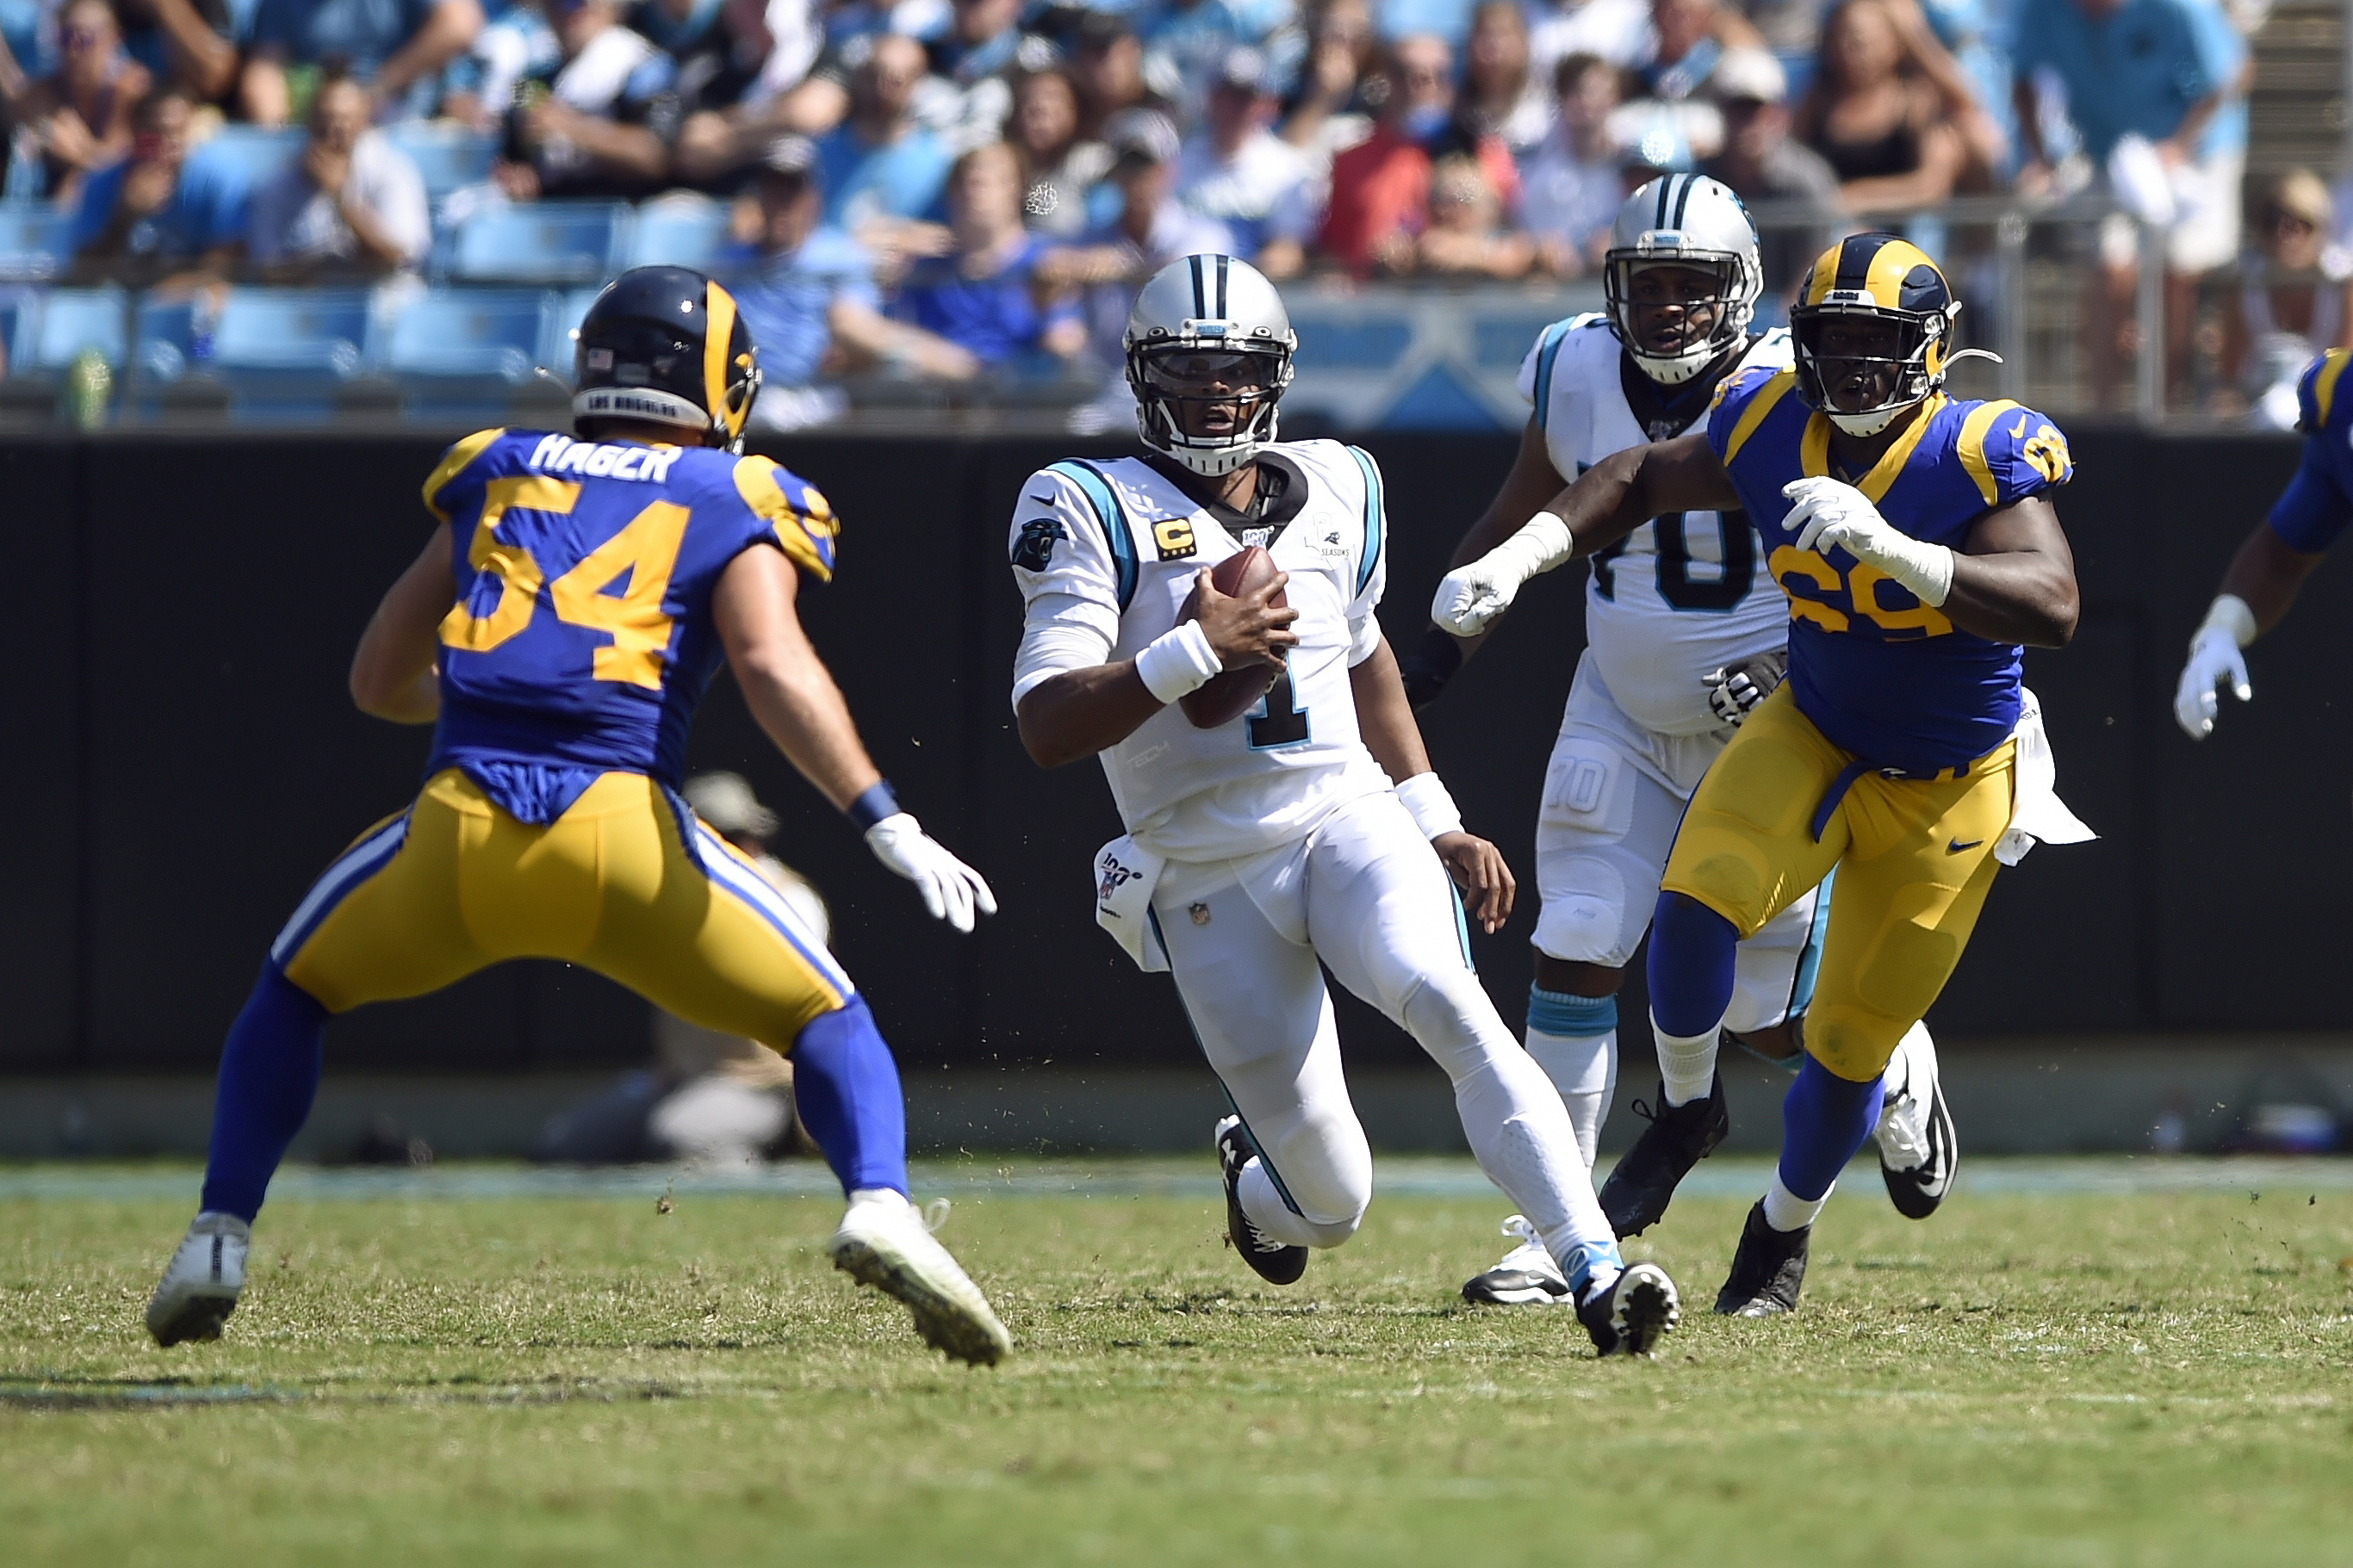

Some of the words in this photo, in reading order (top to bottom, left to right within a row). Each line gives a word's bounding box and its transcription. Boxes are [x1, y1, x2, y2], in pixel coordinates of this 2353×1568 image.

[530, 434, 682, 483] HAGER
[1154, 518, 1194, 550] C
[438, 475, 692, 691] 54
[1768, 543, 1954, 642] 69
[1245, 648, 1312, 752] 1
[1547, 755, 1607, 814] 70
